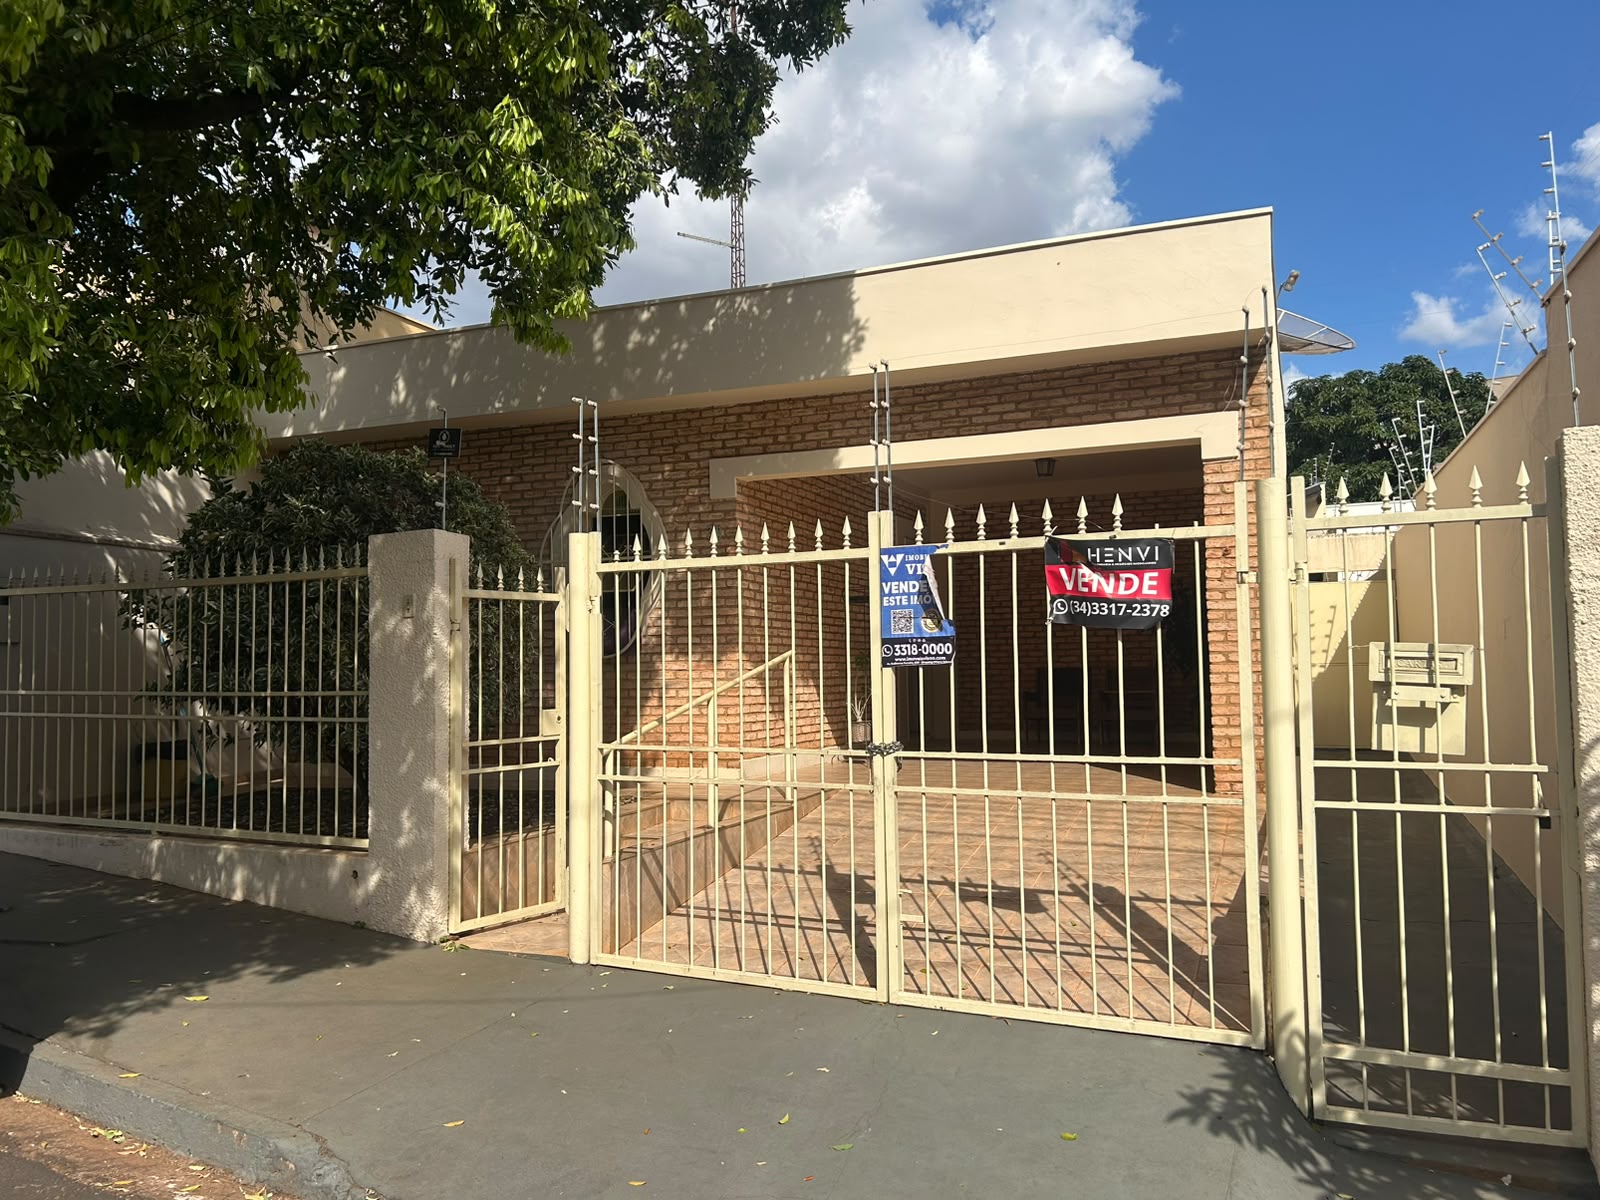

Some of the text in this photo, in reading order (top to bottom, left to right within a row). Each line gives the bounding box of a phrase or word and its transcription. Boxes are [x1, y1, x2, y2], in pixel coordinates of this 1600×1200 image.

[1087, 545, 1159, 563] HENVI
[882, 580, 928, 594] VENDE
[1058, 567, 1159, 595] VENDE
[883, 595, 908, 607] ESTE
[1070, 600, 1170, 617] (34)3317-2378
[893, 642, 953, 656] 3318-0000
